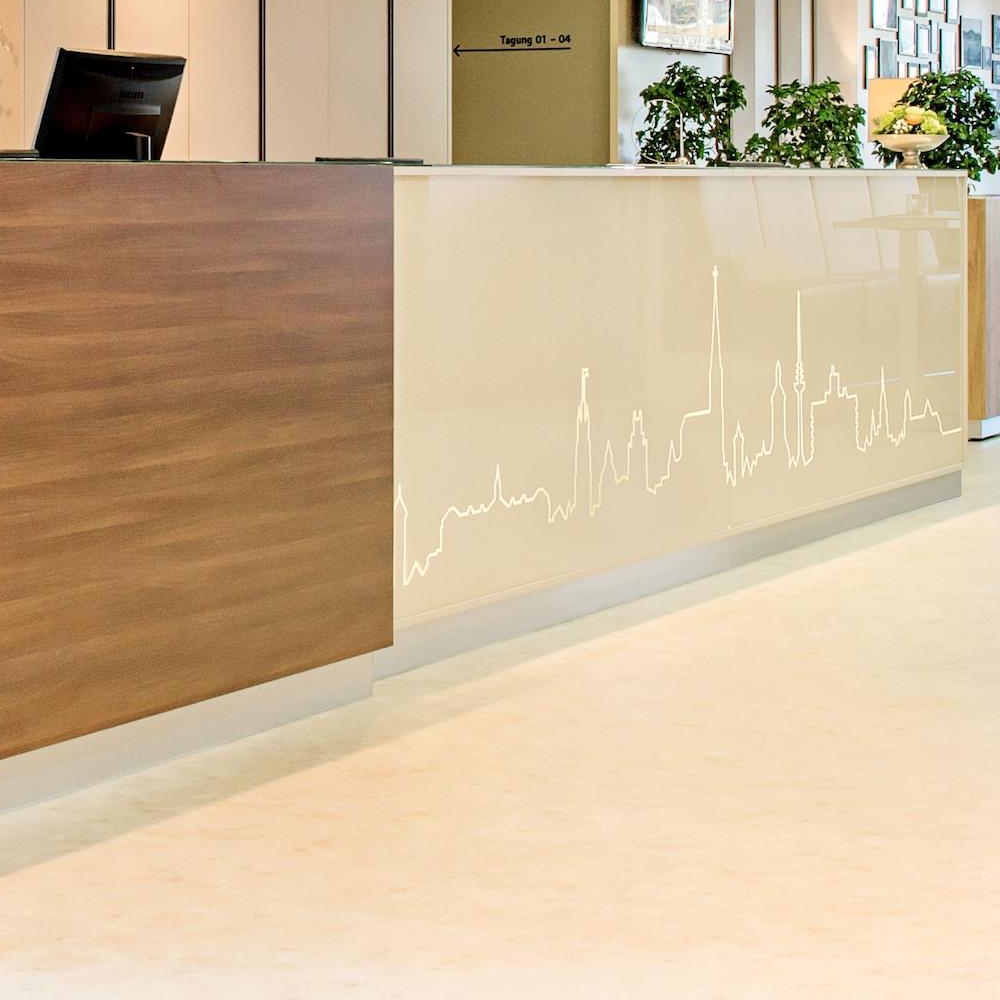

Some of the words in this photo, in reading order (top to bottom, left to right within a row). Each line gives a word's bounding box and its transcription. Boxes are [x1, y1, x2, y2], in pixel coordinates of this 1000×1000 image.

[500, 35, 533, 46] Tagung
[535, 35, 546, 44] 01
[558, 34, 571, 43] 04
